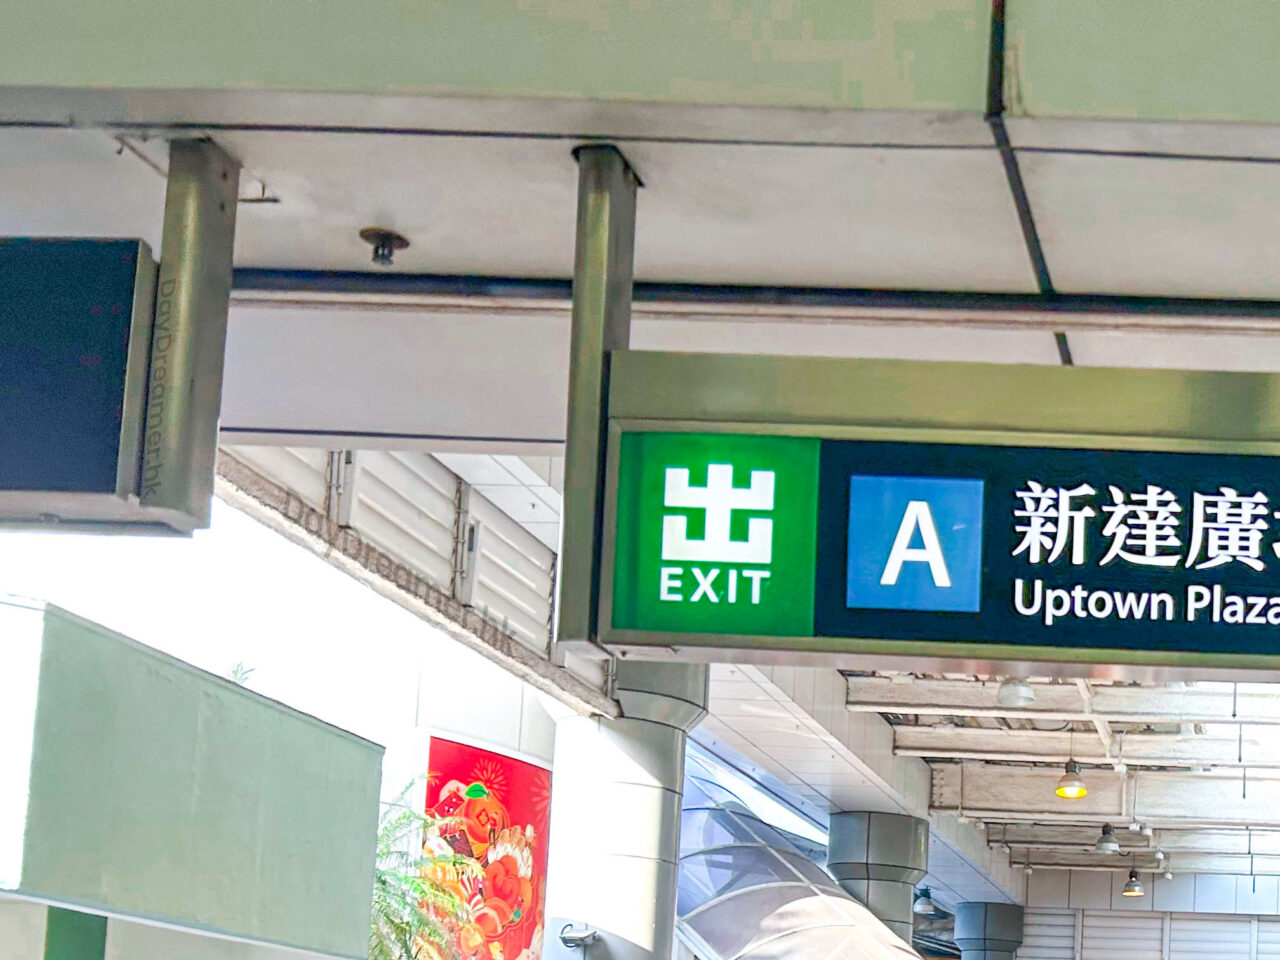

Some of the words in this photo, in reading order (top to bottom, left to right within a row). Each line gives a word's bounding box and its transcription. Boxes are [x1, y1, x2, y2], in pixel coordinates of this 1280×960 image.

[880, 500, 951, 588] A
[660, 565, 773, 605] EXIT
[1014, 579, 1174, 626] Uptown
